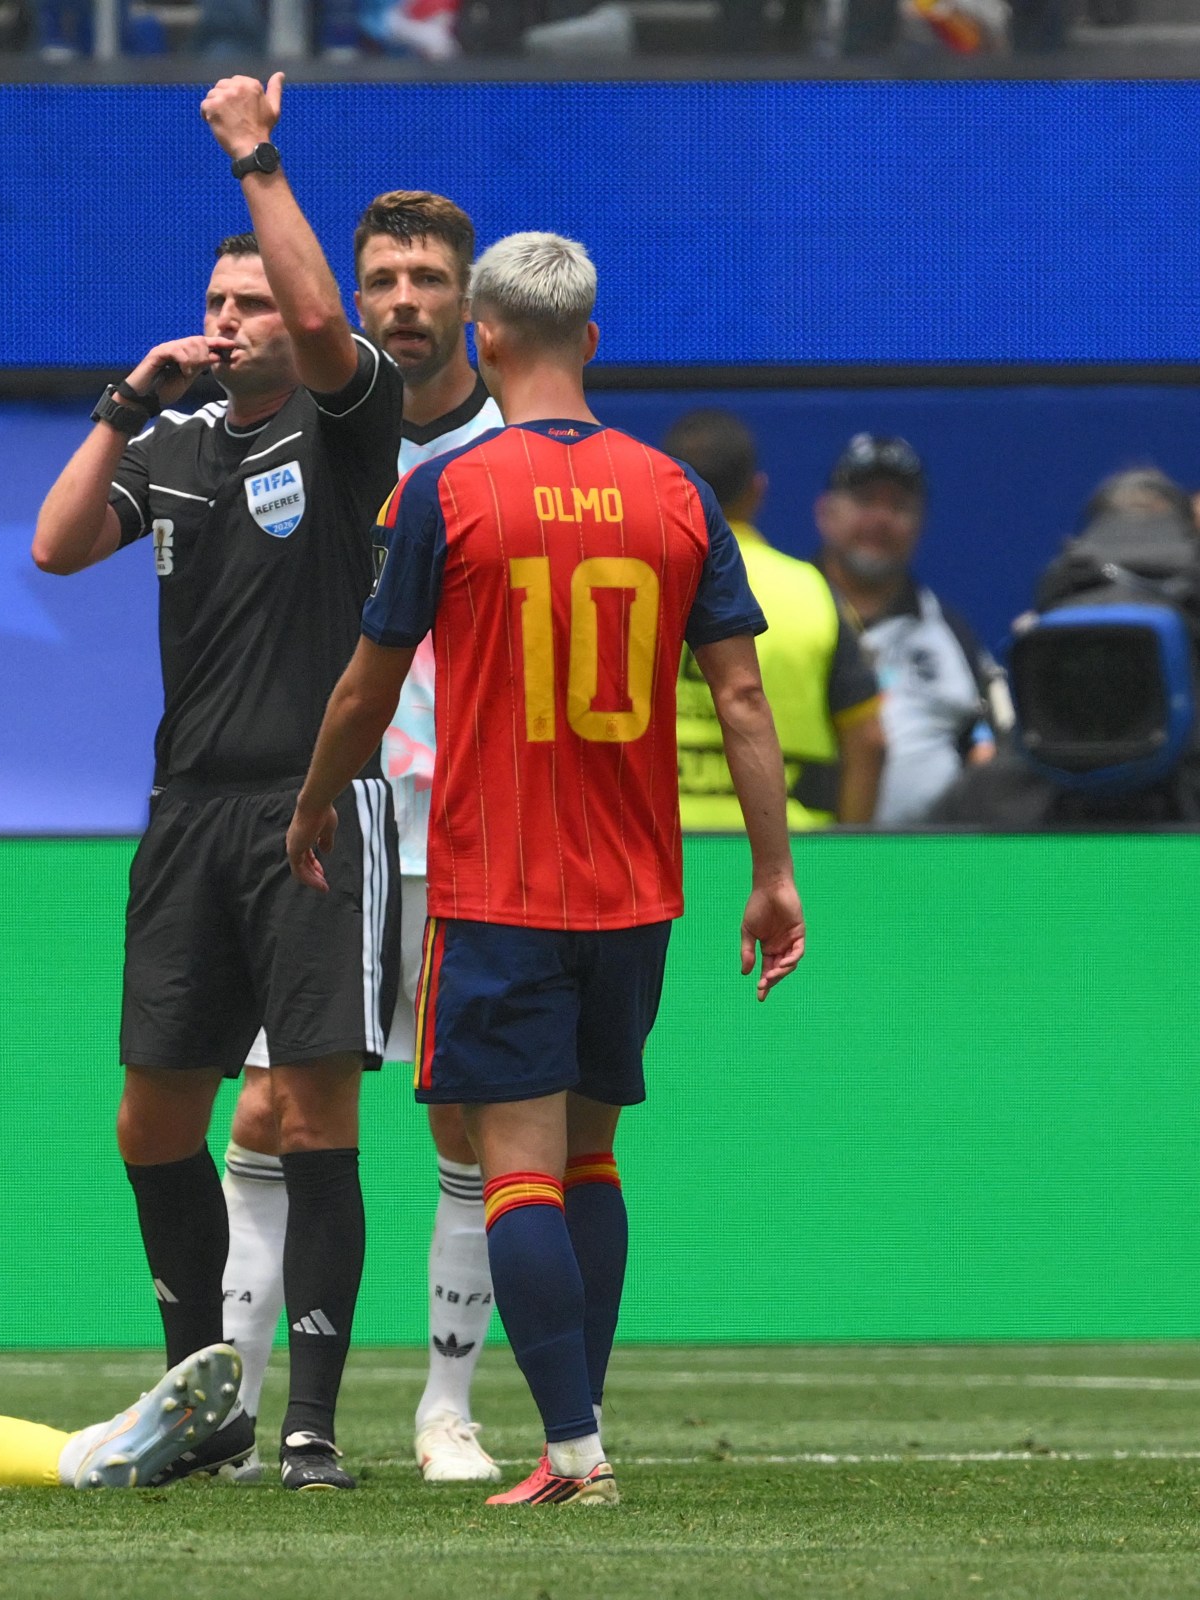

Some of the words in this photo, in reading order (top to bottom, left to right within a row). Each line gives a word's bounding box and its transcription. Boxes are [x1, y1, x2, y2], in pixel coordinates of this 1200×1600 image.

[251, 469, 296, 496] FIFA
[255, 493, 300, 515] REFEREE
[533, 486, 624, 523] OLMO
[272, 520, 295, 533] 2026
[508, 556, 660, 742] 10
